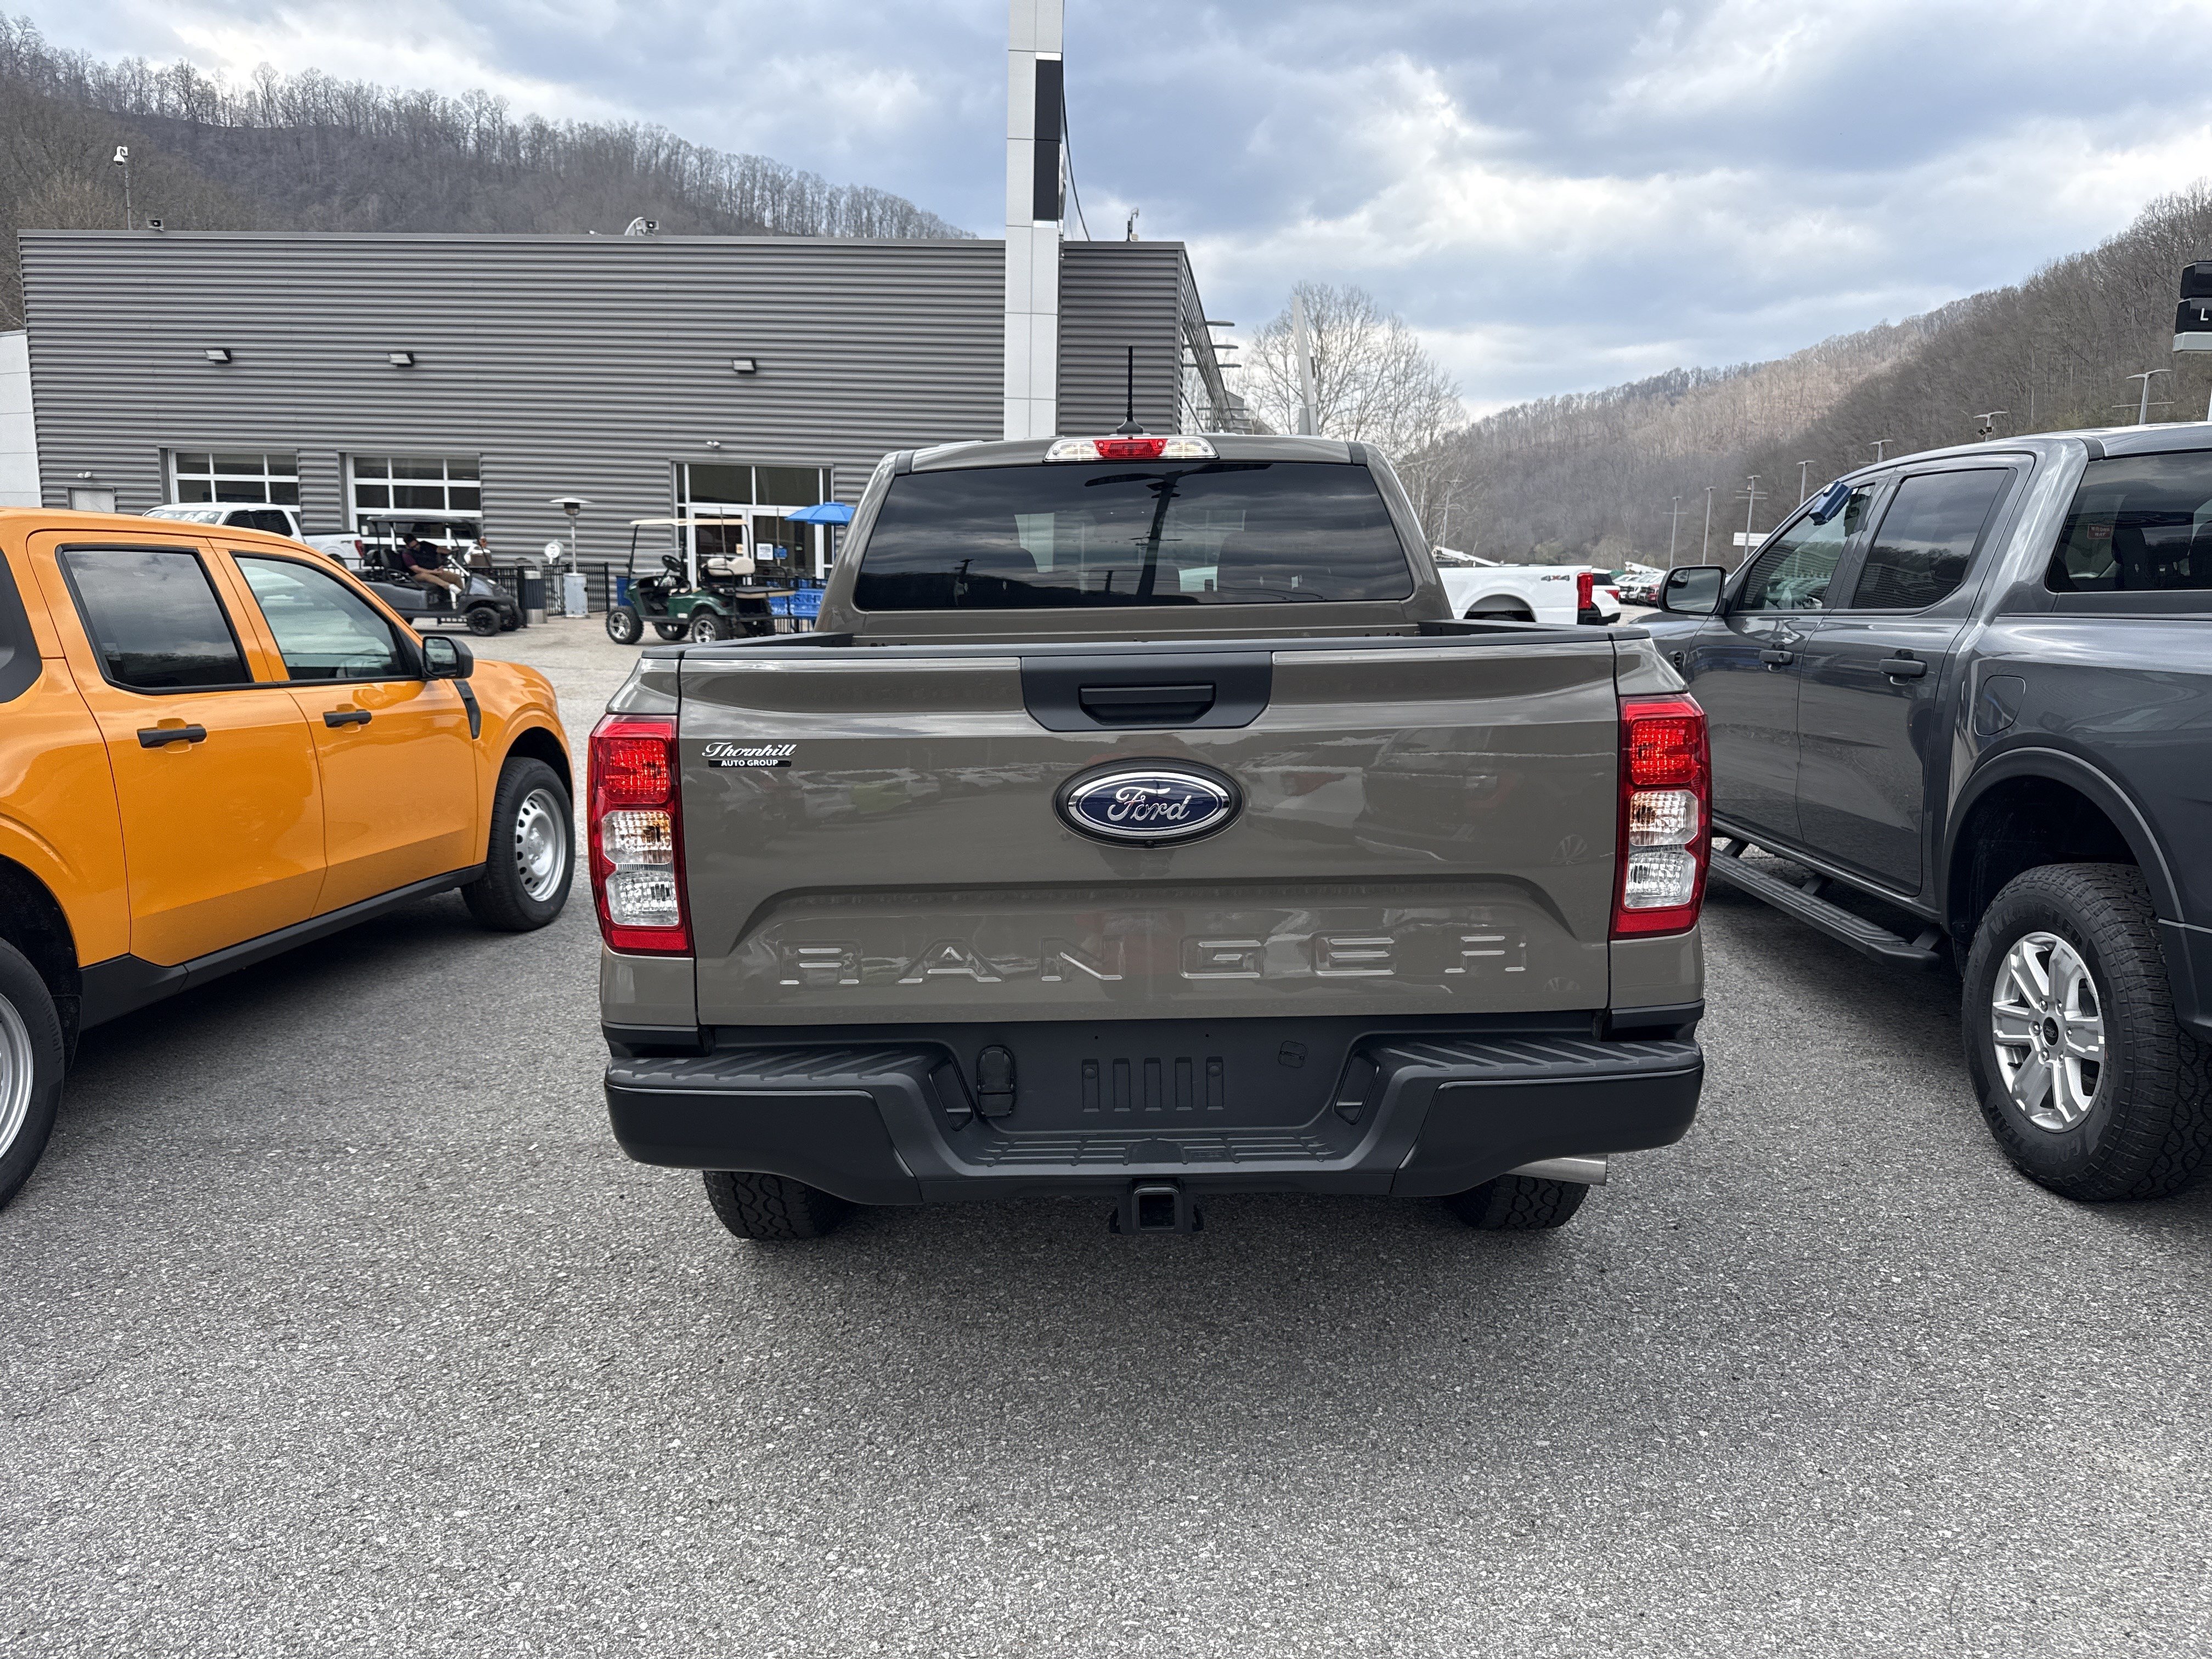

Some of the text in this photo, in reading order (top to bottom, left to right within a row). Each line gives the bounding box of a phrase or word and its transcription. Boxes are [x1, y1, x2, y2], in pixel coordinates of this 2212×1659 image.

[702, 742, 797, 757] Thornhill
[1107, 786, 1192, 821] Ford
[778, 933, 1527, 986] RANGER
